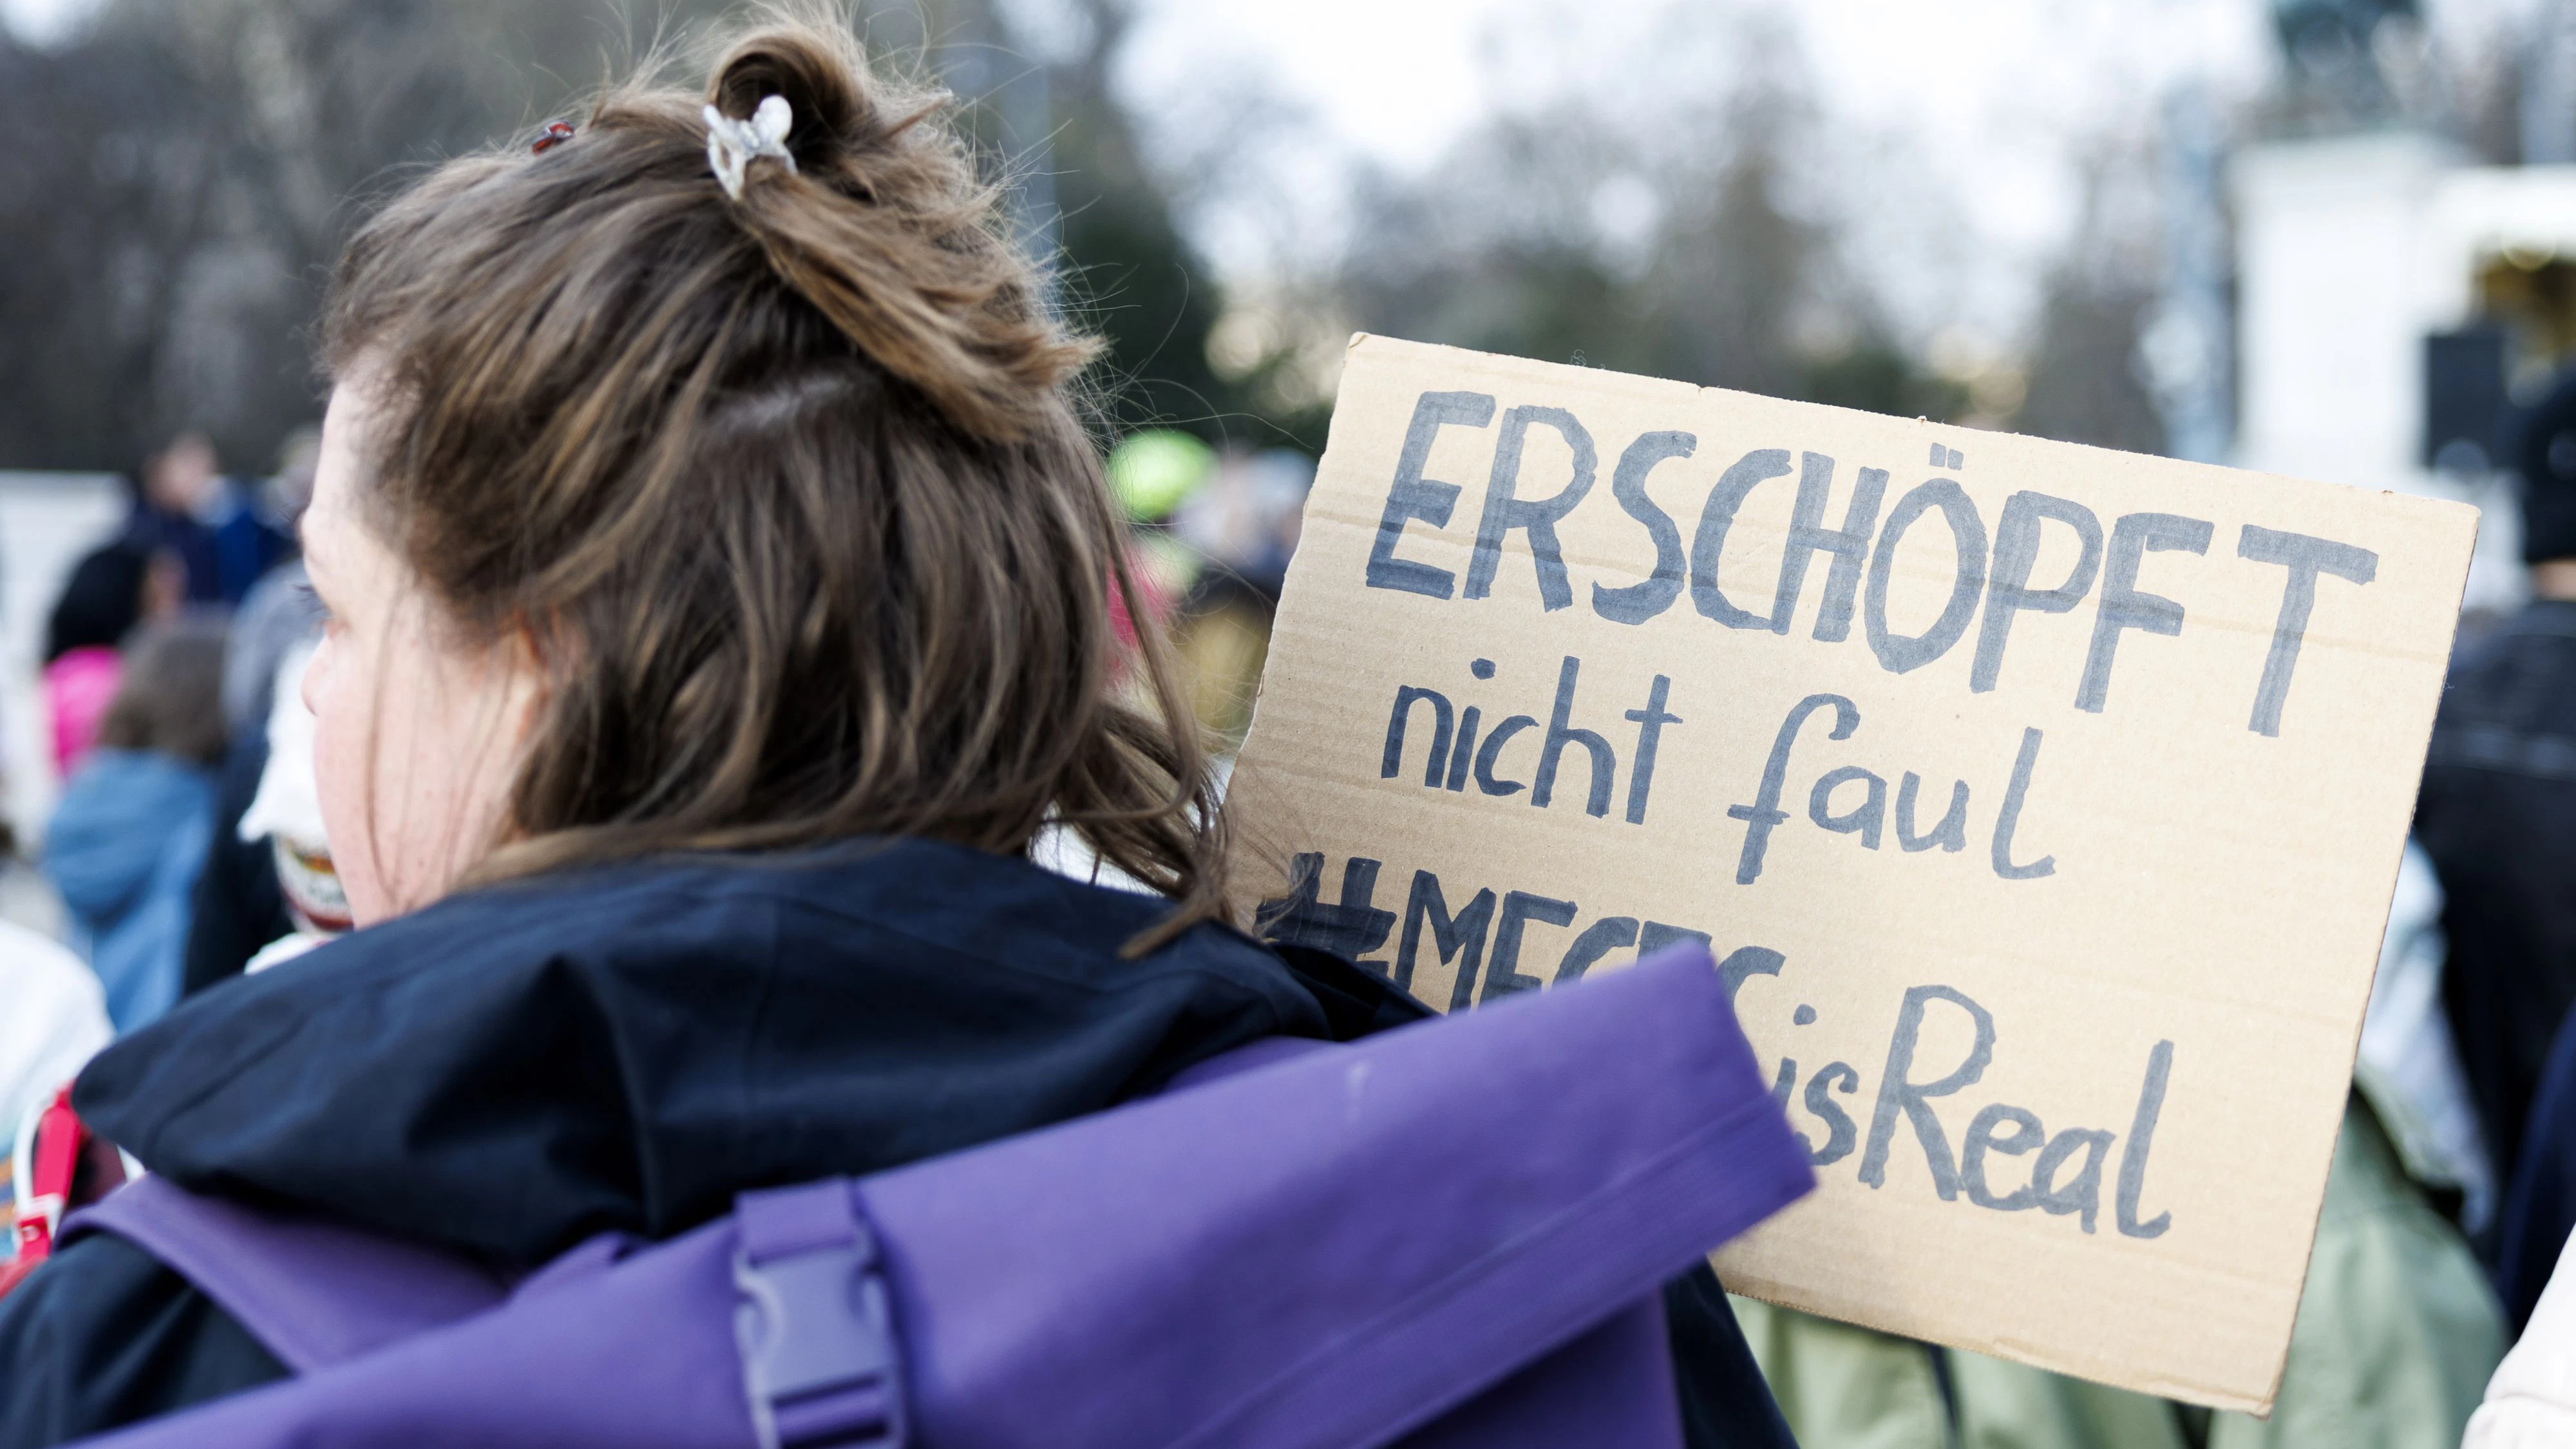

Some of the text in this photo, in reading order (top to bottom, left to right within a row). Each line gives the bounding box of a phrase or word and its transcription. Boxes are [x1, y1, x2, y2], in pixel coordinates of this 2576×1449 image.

[1365, 390, 2378, 737] ERSCHÖPFT
[1381, 656, 2056, 885] nicht faul
